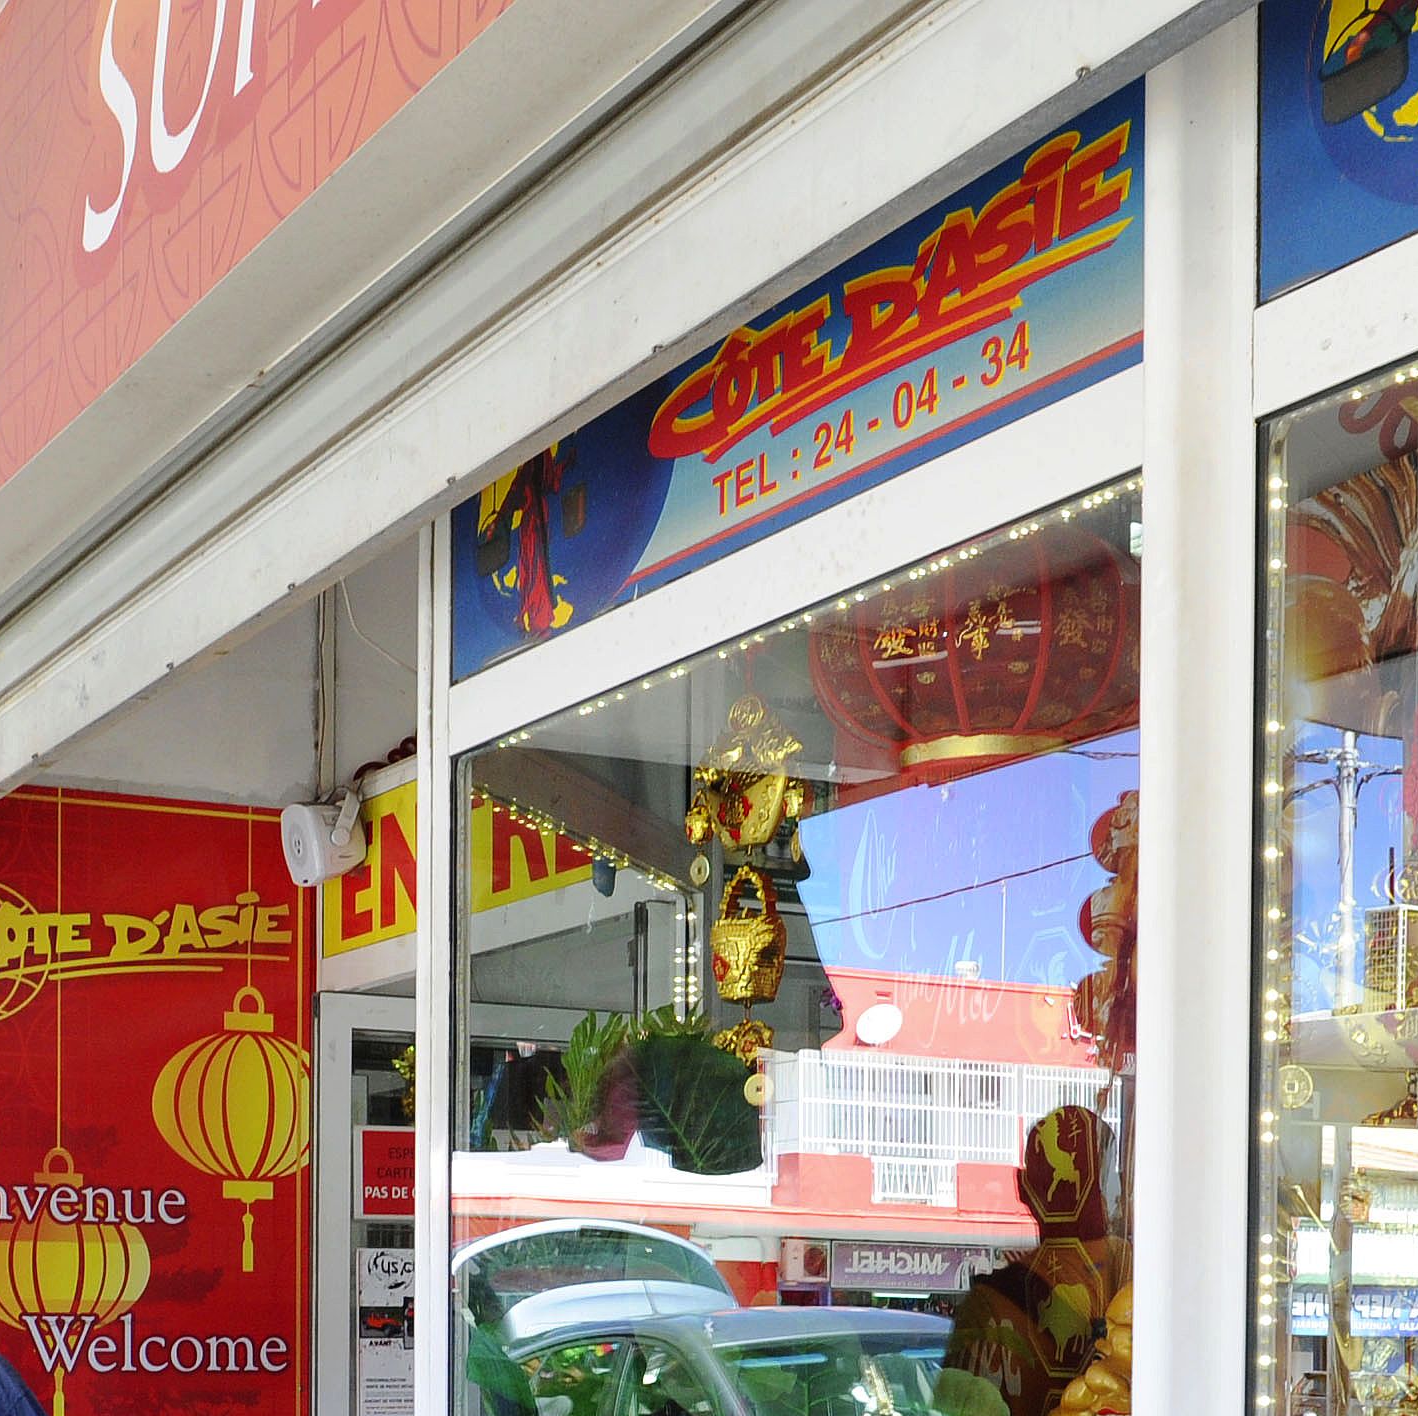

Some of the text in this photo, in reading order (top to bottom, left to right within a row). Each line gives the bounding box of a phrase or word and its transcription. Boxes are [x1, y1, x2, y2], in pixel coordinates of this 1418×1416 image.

[713, 453, 777, 515] TEL
[813, 409, 855, 470] 24
[893, 367, 938, 429] 04
[981, 320, 1031, 388] 34
[103, 890, 293, 962] D'ASIE
[1067, 1110, 1083, 1148] 羊
[364, 1186, 409, 1199] PAS DE
[22, 1313, 288, 1373] Welcome
